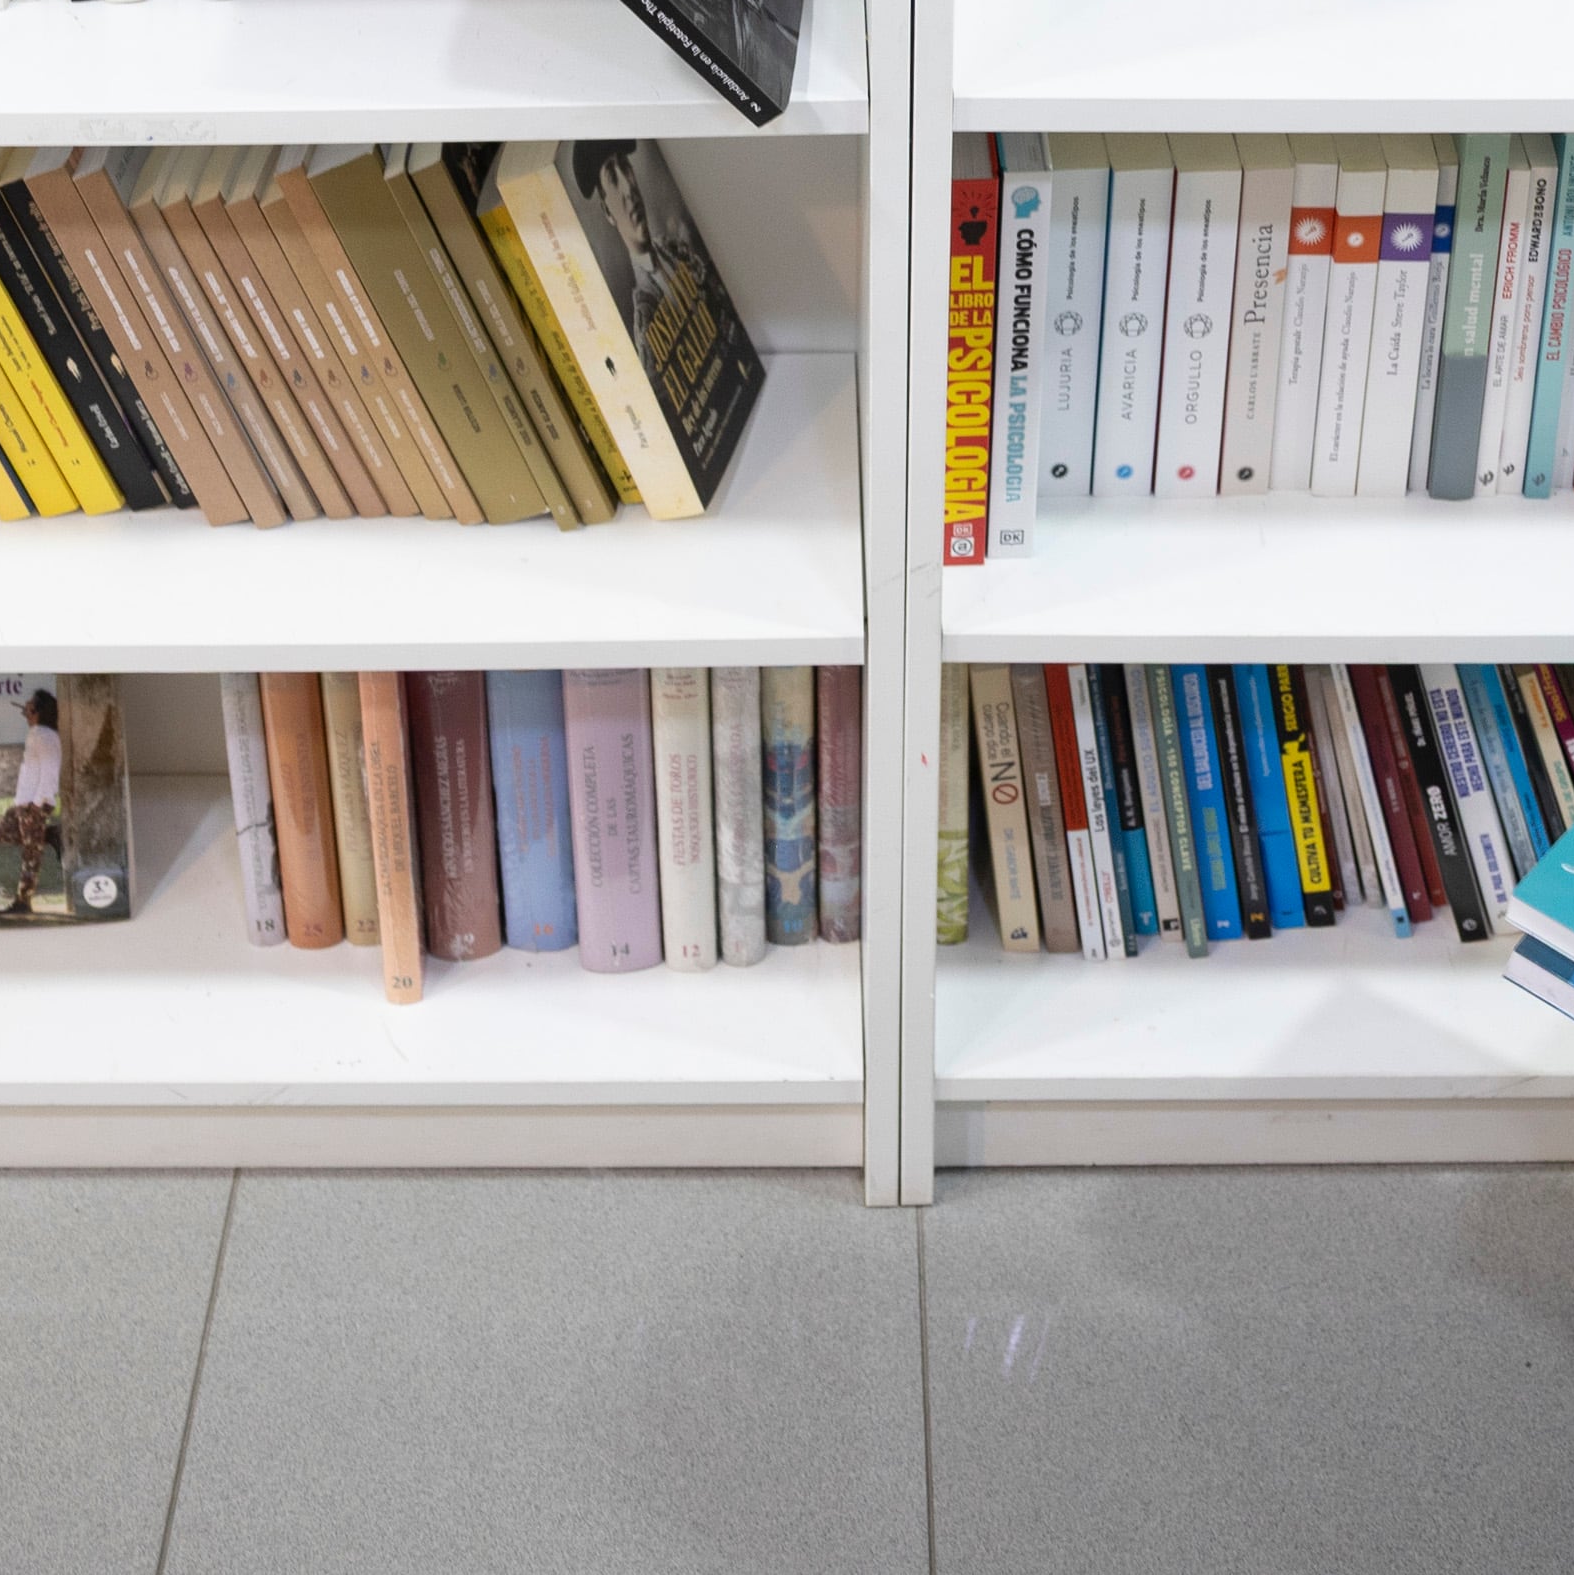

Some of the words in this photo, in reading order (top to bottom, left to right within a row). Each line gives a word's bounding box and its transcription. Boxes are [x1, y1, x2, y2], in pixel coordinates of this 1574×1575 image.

[951, 256, 995, 291] EL
[1016, 228, 1034, 280] CÓMO
[1243, 223, 1275, 325] Presencia
[949, 293, 994, 309] LIBRO
[950, 310, 974, 325] DE
[975, 310, 993, 325] LA
[1009, 282, 1032, 372] FUNCIONA
[1008, 375, 1028, 409] LA
[1057, 346, 1073, 412] LUJURIA
[1120, 347, 1138, 421] AVARICIA
[1184, 349, 1204, 426] ORGULLO
[945, 328, 993, 523] PSICOLOGIA
[1005, 412, 1027, 503] PSICOLOGIA
[1293, 760, 1311, 822] MEMESFERA
[1303, 826, 1314, 840] TU
[1310, 844, 1322, 884] CULTIVA
[392, 975, 413, 990] 20
